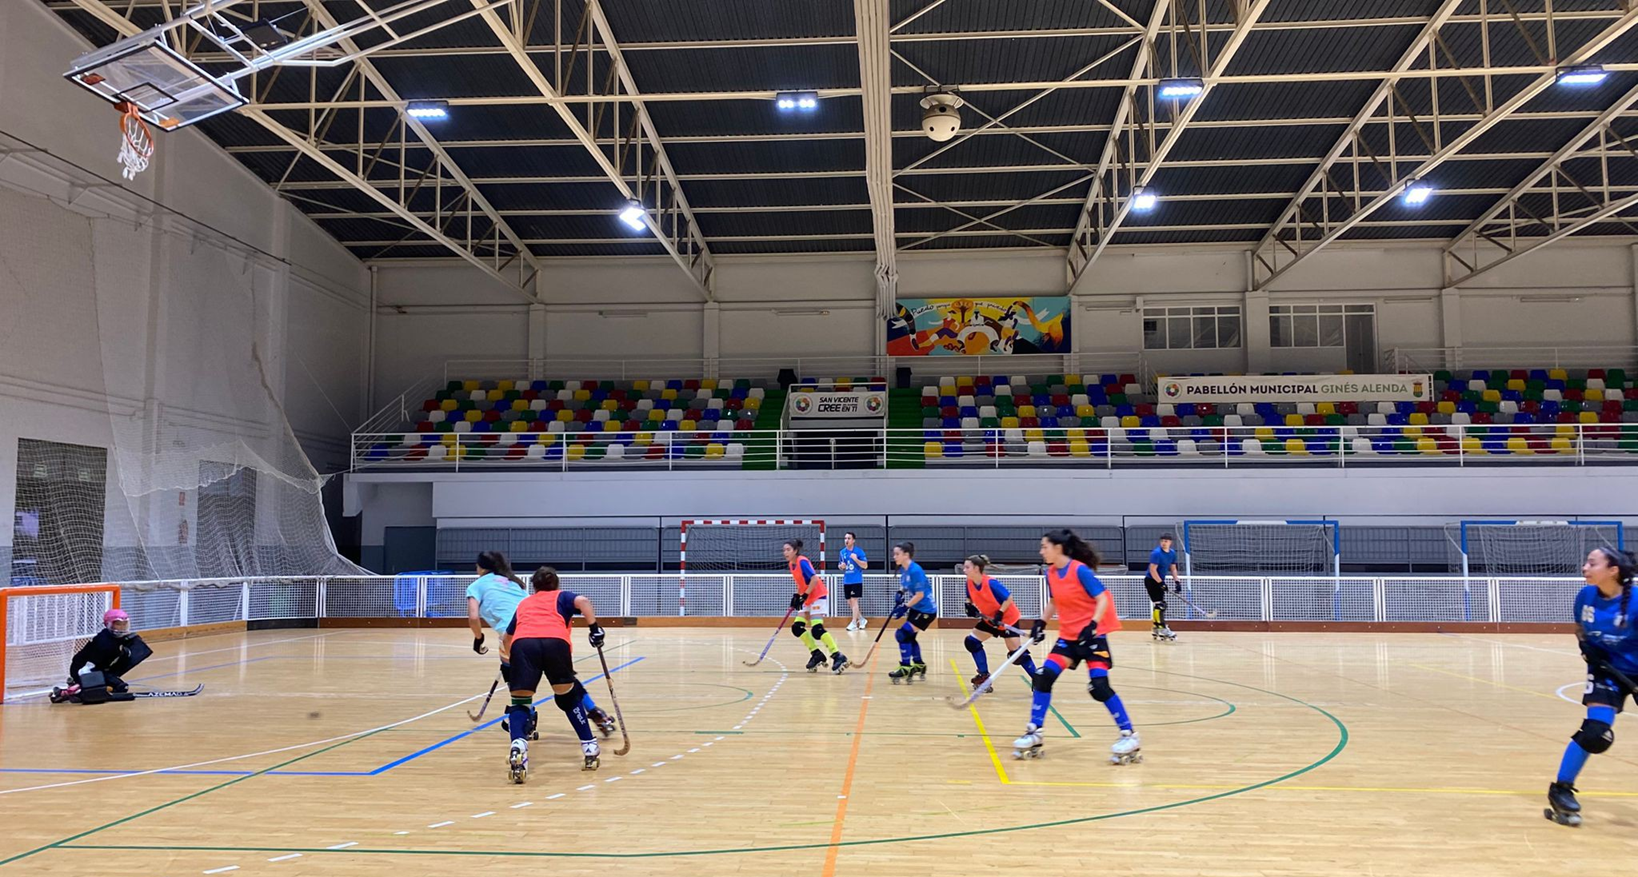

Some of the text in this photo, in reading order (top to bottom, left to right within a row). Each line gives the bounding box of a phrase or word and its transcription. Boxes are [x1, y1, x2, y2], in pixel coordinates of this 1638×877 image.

[1186, 382, 1408, 395] PABELLÓN MUNICIPAL GINÉS ALENDA
